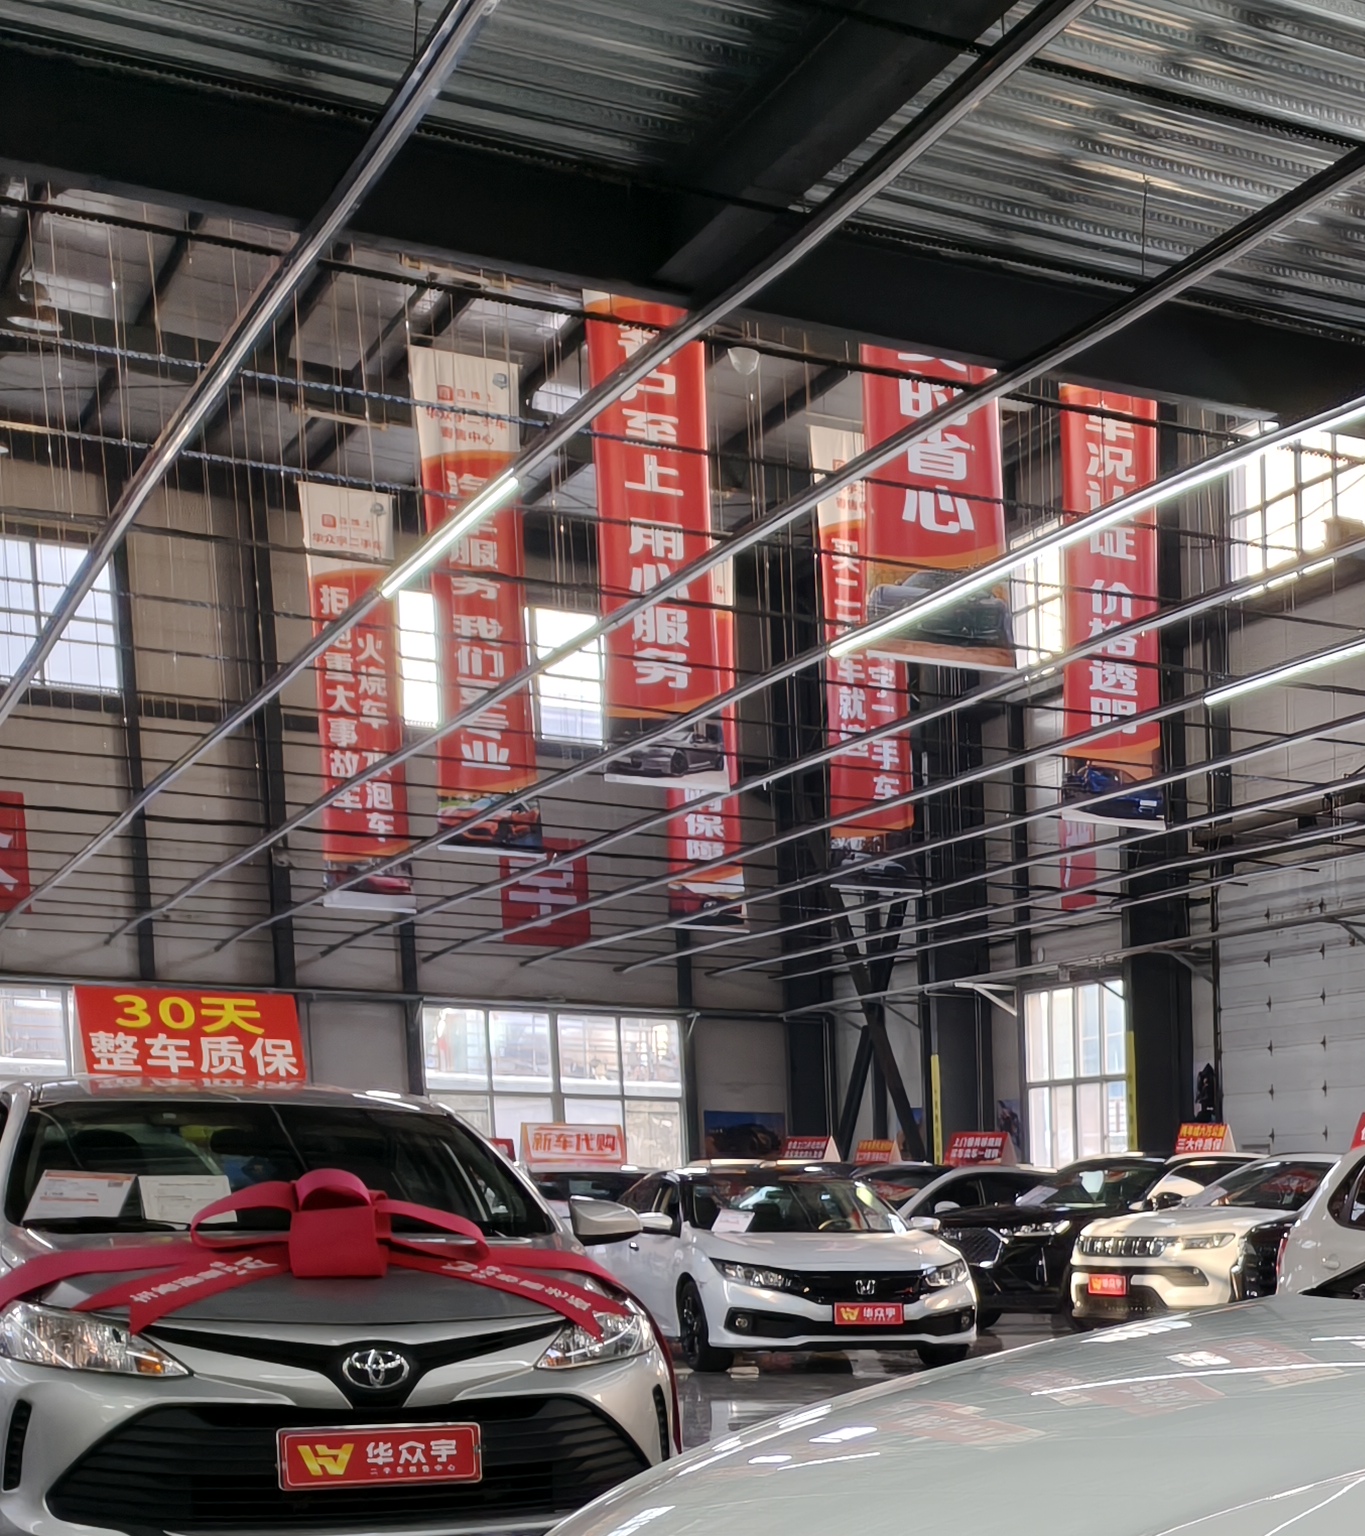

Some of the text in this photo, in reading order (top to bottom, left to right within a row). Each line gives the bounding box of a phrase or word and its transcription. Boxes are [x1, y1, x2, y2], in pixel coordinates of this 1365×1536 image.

[898, 353, 975, 534] 的省心
[447, 470, 500, 599] 汽服务
[629, 517, 691, 688] 用心服务
[1089, 579, 1138, 734] 价格透明
[357, 633, 389, 730] 火烧车
[866, 651, 899, 800] 宇二手车
[89, 1031, 299, 1077] 整车质保
[113, 994, 265, 1034] 30天
[533, 1132, 616, 1152] 新车代购
[366, 1438, 458, 1466] 华众宇
